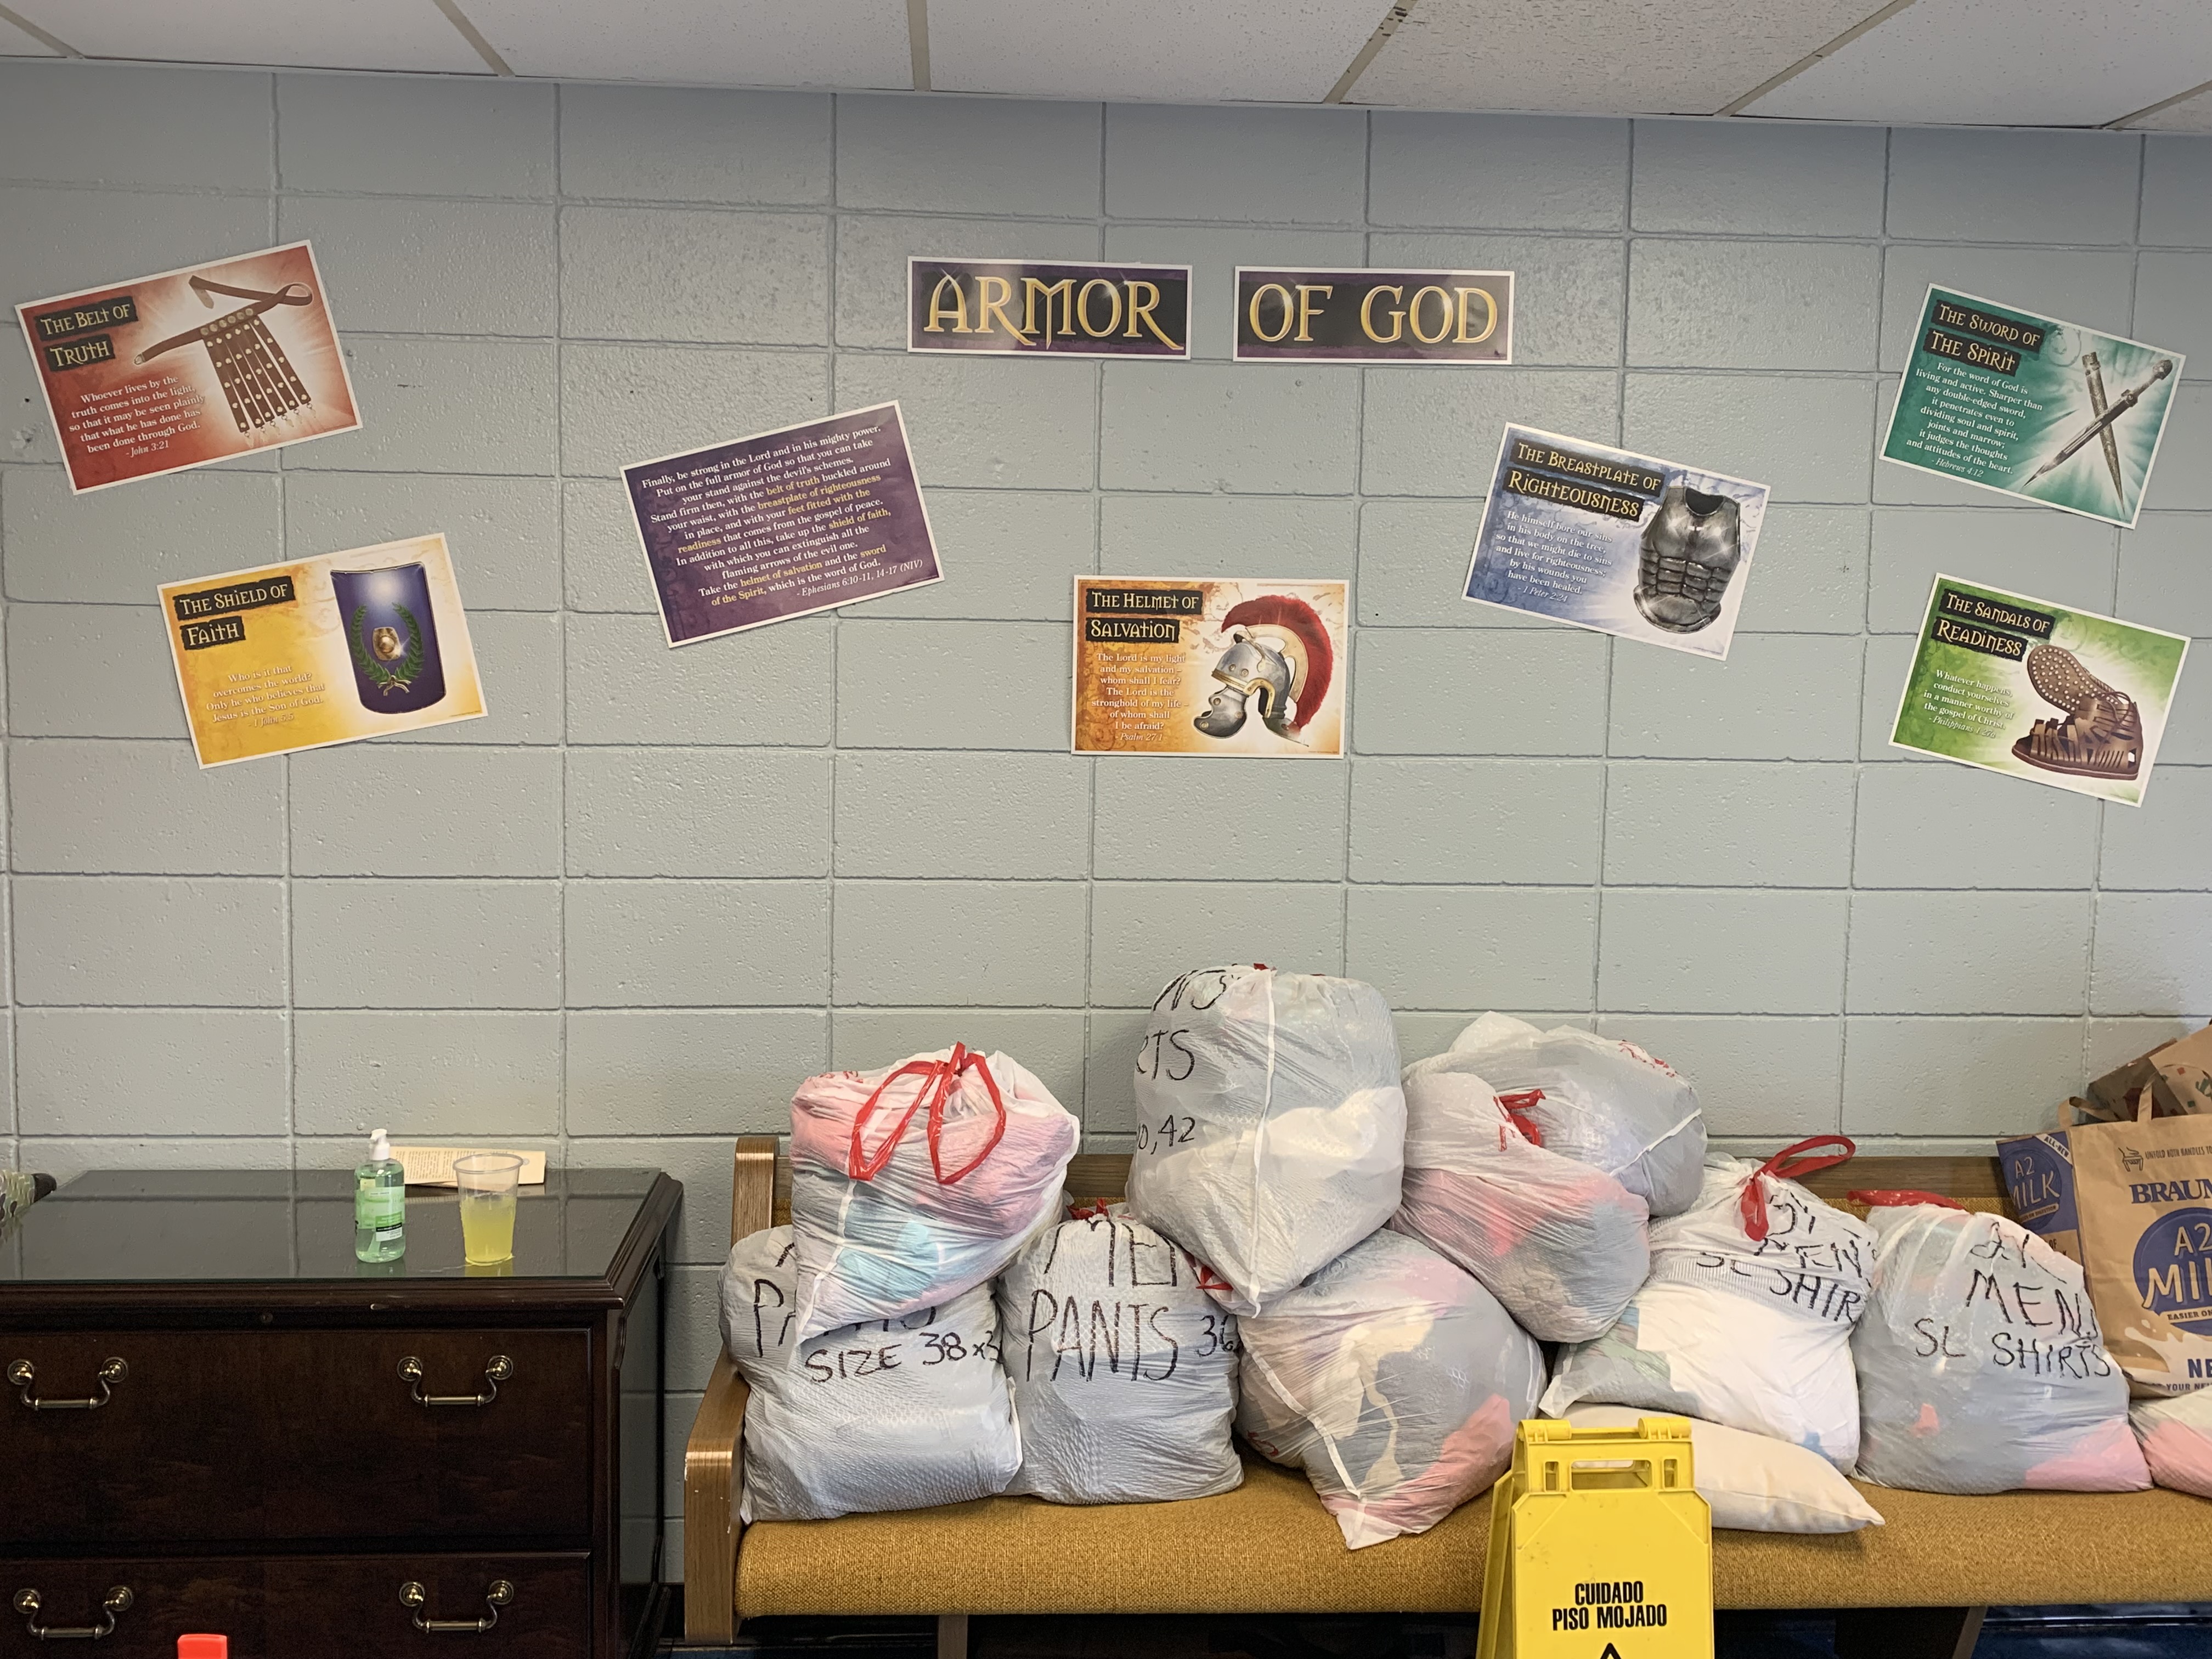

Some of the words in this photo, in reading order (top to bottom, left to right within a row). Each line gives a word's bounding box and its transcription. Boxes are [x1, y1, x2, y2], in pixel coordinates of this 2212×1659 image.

[924, 275, 1184, 351] ARMOR
[1249, 284, 1332, 342] OF
[1360, 284, 1498, 344] GOD
[80, 389, 123, 403] Whoever
[124, 383, 147, 393] lives
[148, 379, 162, 389] by
[162, 375, 179, 385] the
[1915, 369, 1940, 385] living
[1941, 378, 1958, 387] and
[1959, 383, 1985, 395] active.
[1988, 388, 2022, 404] Sharper
[2023, 399, 2043, 410] than
[1937, 363, 1951, 373] For
[1953, 368, 1967, 377] the
[1968, 374, 1990, 383] word
[2001, 380, 2019, 391] God
[2020, 386, 2028, 394] is
[80, 431, 100, 442] that
[101, 425, 125, 437] what
[125, 422, 138, 431] he
[139, 419, 157, 427] has
[157, 413, 182, 424] done
[183, 409, 201, 417] has
[641, 475, 676, 488] Finally,
[676, 471, 689, 479] be
[690, 465, 720, 476] strong
[731, 458, 747, 466] the
[748, 450, 771, 462] Lord
[772, 445, 790, 457] and
[803, 441, 818, 449] his
[819, 433, 851, 445] mighty
[852, 427, 881, 441] power.
[650, 509, 677, 523] Stand
[679, 506, 699, 516] firm
[701, 501, 725, 510] then,
[726, 493, 747, 504] with
[749, 489, 764, 499] the
[765, 484, 783, 495] belt
[785, 481, 794, 490] of
[795, 475, 820, 488] truth
[821, 466, 857, 481] buckled
[859, 458, 891, 472] around
[689, 549, 725, 563] addition
[738, 540, 751, 550] all
[752, 538, 774, 547] this,
[775, 531, 795, 541] take
[797, 528, 810, 537] up
[811, 523, 826, 533] the
[828, 515, 854, 528] shield
[856, 512, 866, 521] of
[866, 507, 891, 519] faith,
[1506, 523, 1516, 531] in
[1517, 525, 1531, 535] his
[1533, 528, 1554, 543] body
[1570, 538, 1584, 547] the
[1586, 542, 1606, 554] tree,
[1496, 546, 1513, 554] and
[1514, 548, 1530, 558] live
[1531, 552, 1543, 561] for
[1545, 557, 1606, 578] righteousness;
[1166, 654, 1185, 664] light
[1933, 683, 1966, 695] conduct
[1966, 691, 2010, 706] yourselves
[1934, 669, 1974, 686] Whatever
[1976, 680, 2013, 697] happens,
[1940, 696, 1972, 709] manner
[1974, 705, 2002, 718] worthy
[2044, 1136, 2069, 1158] ALL-NEW
[2145, 1149, 2165, 1160] UNFOLD
[2180, 1146, 2205, 1156] HANDLES
[2015, 1156, 2035, 1179] A2
[2174, 1223, 2212, 1256] A2
[2167, 1311, 2199, 1321] EASIER
[1026, 1289, 1178, 1381] PANTS
[1914, 1318, 1966, 1357] SL
[1992, 1332, 2112, 1379] SHIRTS
[805, 1344, 902, 1384] SIZE
[2166, 1383, 2191, 1391] YOUR
[1575, 1581, 1644, 1606] CUIDADO
[1552, 1607, 1589, 1631] PISO
[1597, 1604, 1667, 1628] MOJADO
